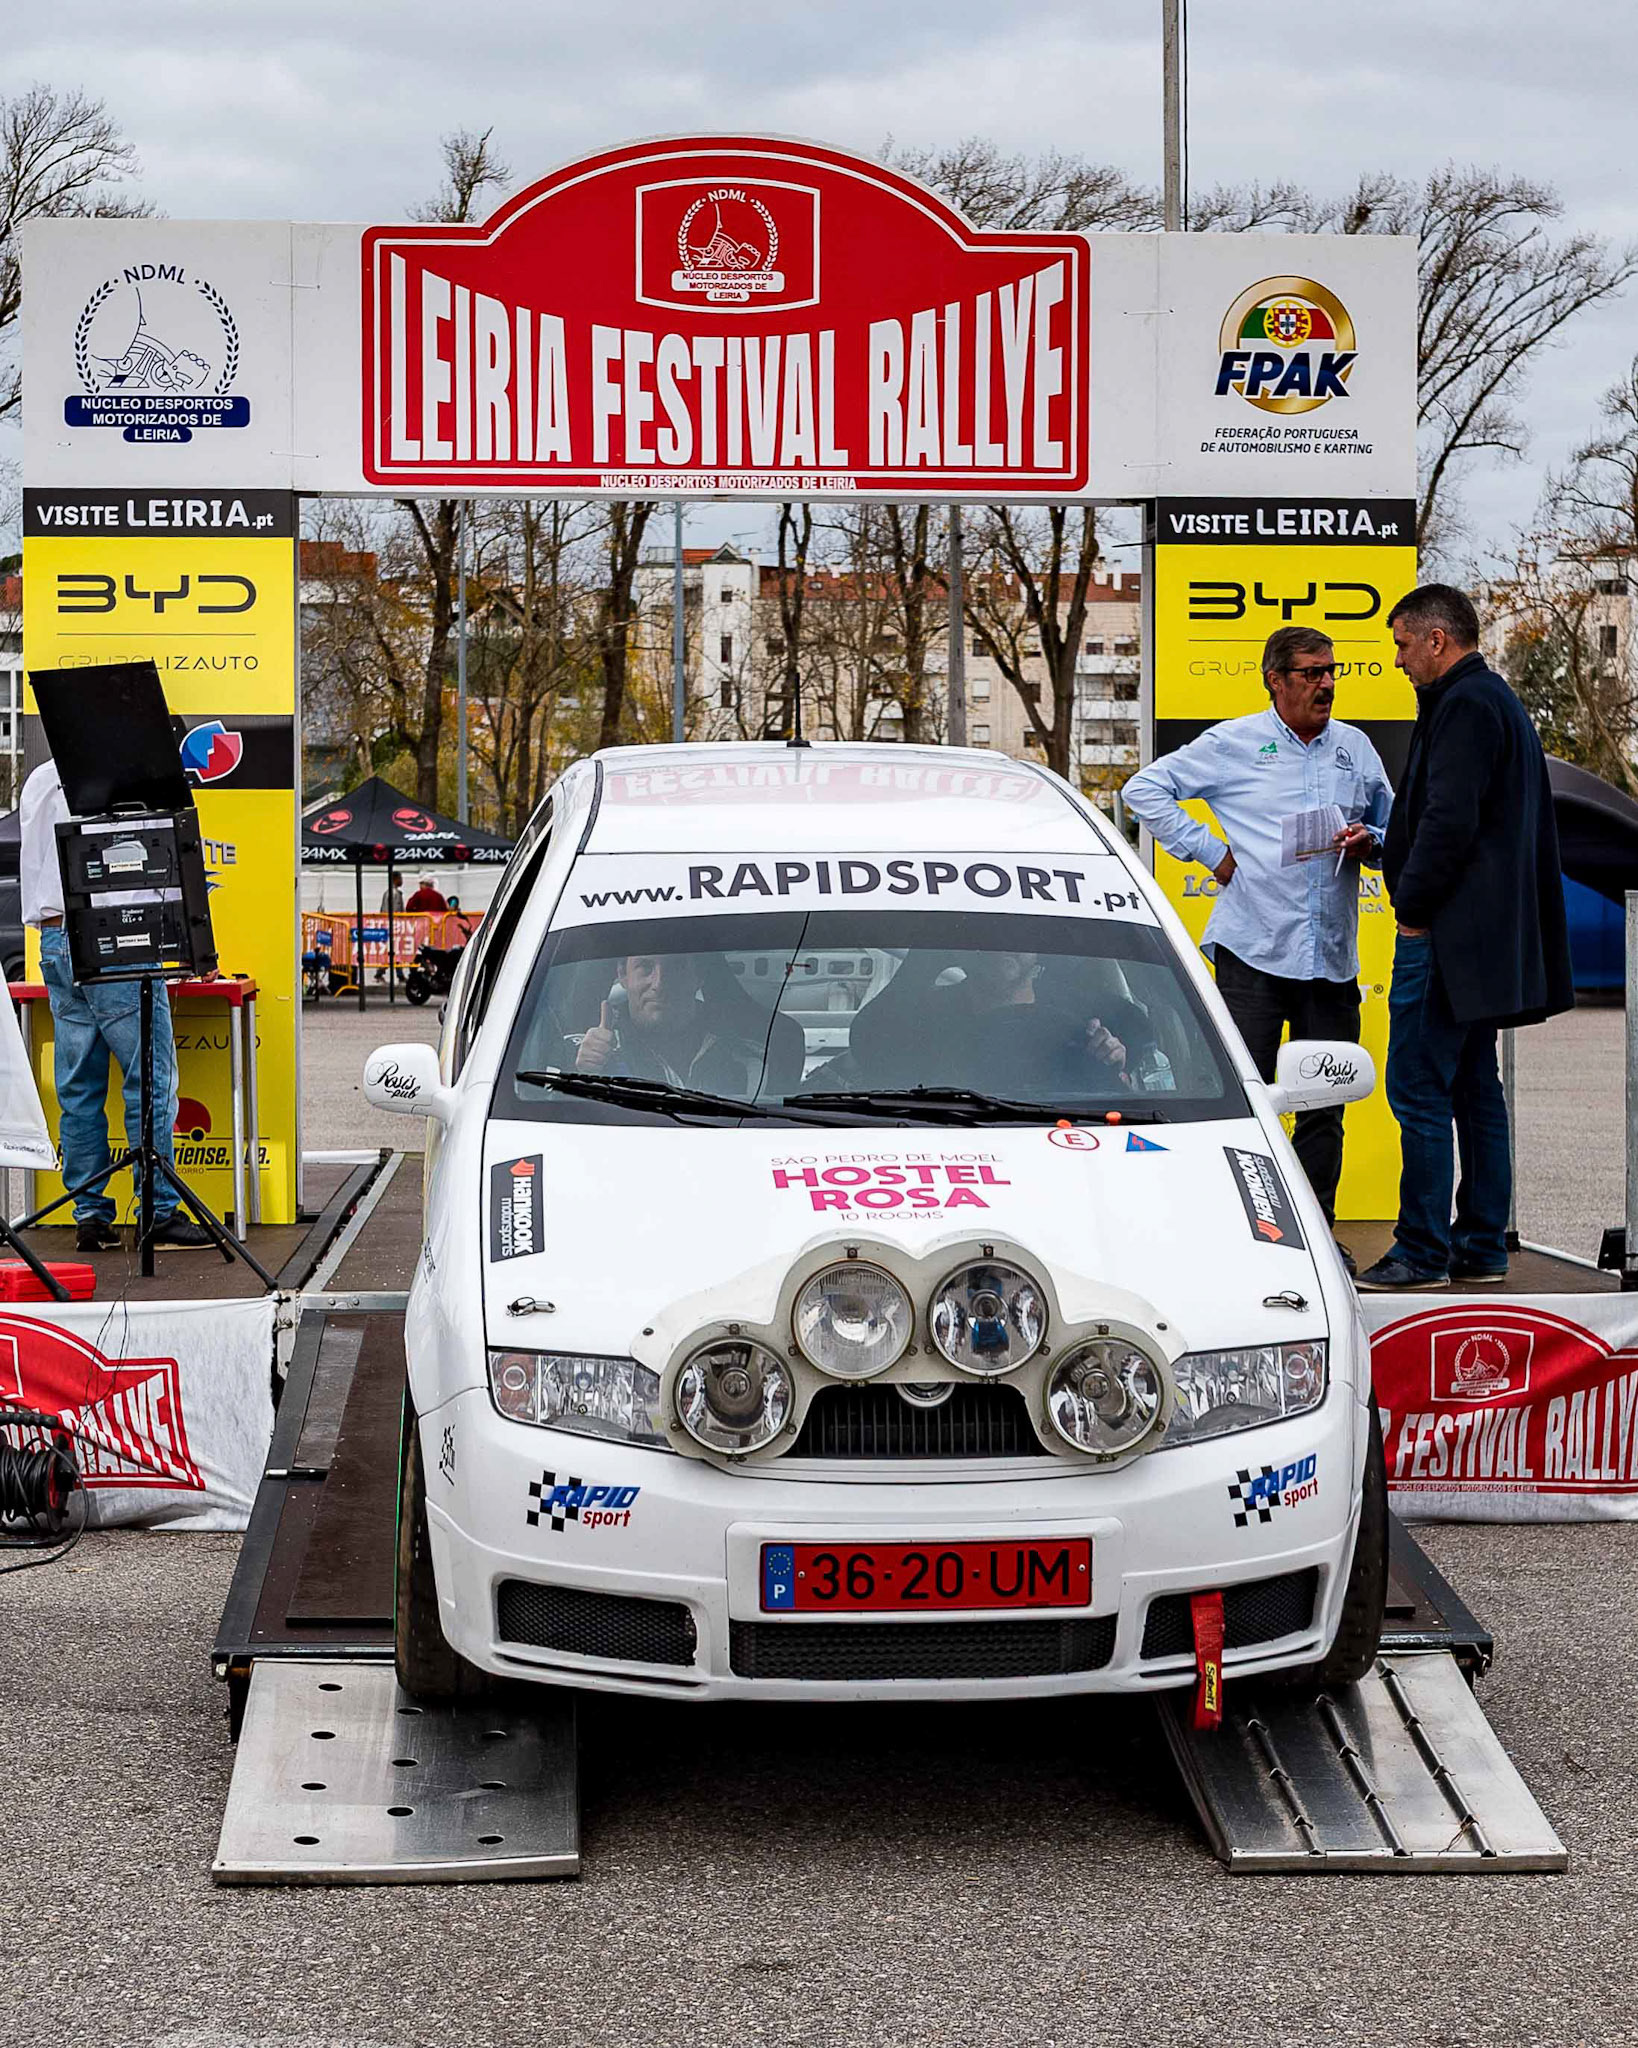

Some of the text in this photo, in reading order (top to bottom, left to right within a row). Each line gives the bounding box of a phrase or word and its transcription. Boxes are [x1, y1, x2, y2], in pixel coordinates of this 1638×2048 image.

[707, 189, 747, 203] NDML
[123, 263, 187, 286] NDML
[720, 273, 774, 281] DESPORTOS
[689, 282, 753, 290] MOTORIZADOS
[390, 251, 1064, 469] LEIRIA FESTIVAL RALLYE
[1213, 350, 1360, 398] FPAK
[81, 395, 234, 411] NÚCLEO DESPORTOS
[92, 412, 223, 426] MOTORIZADOS DE
[134, 428, 181, 441] LEIRIA
[1215, 427, 1359, 440] FEDERAÇÃO PORTUGUESA
[1200, 442, 1373, 454] DE AUTOMOBILISMO E KARTING
[649, 476, 716, 489] DESPORTOS
[718, 476, 800, 489] MOTORIZADOS
[802, 476, 817, 489] DE
[819, 477, 857, 490] LEIRIA
[37, 500, 274, 529] VISITE LEIRIA.pt
[1169, 508, 1398, 538] VISITE LEIRIA.pt
[57, 574, 257, 613] BYD
[1188, 581, 1382, 620] BYD
[1325, 1069, 1359, 1088] pub
[384, 1085, 421, 1100] pub
[1066, 1133, 1085, 1146] E
[825, 1154, 899, 1163] PEDRO
[905, 1153, 935, 1162] DE
[940, 1153, 1003, 1162] MOEL
[772, 1165, 1012, 1189] HOSTEL
[809, 1187, 991, 1211] ROSA
[840, 1210, 944, 1222] 10 ROOMS
[1394, 1404, 1534, 1479] FESTIVAL
[1246, 1453, 1317, 1505] RAPID
[546, 1485, 641, 1508] RAPID
[1284, 1477, 1319, 1508] sport
[582, 1509, 631, 1529] sport
[773, 1583, 786, 1600] P
